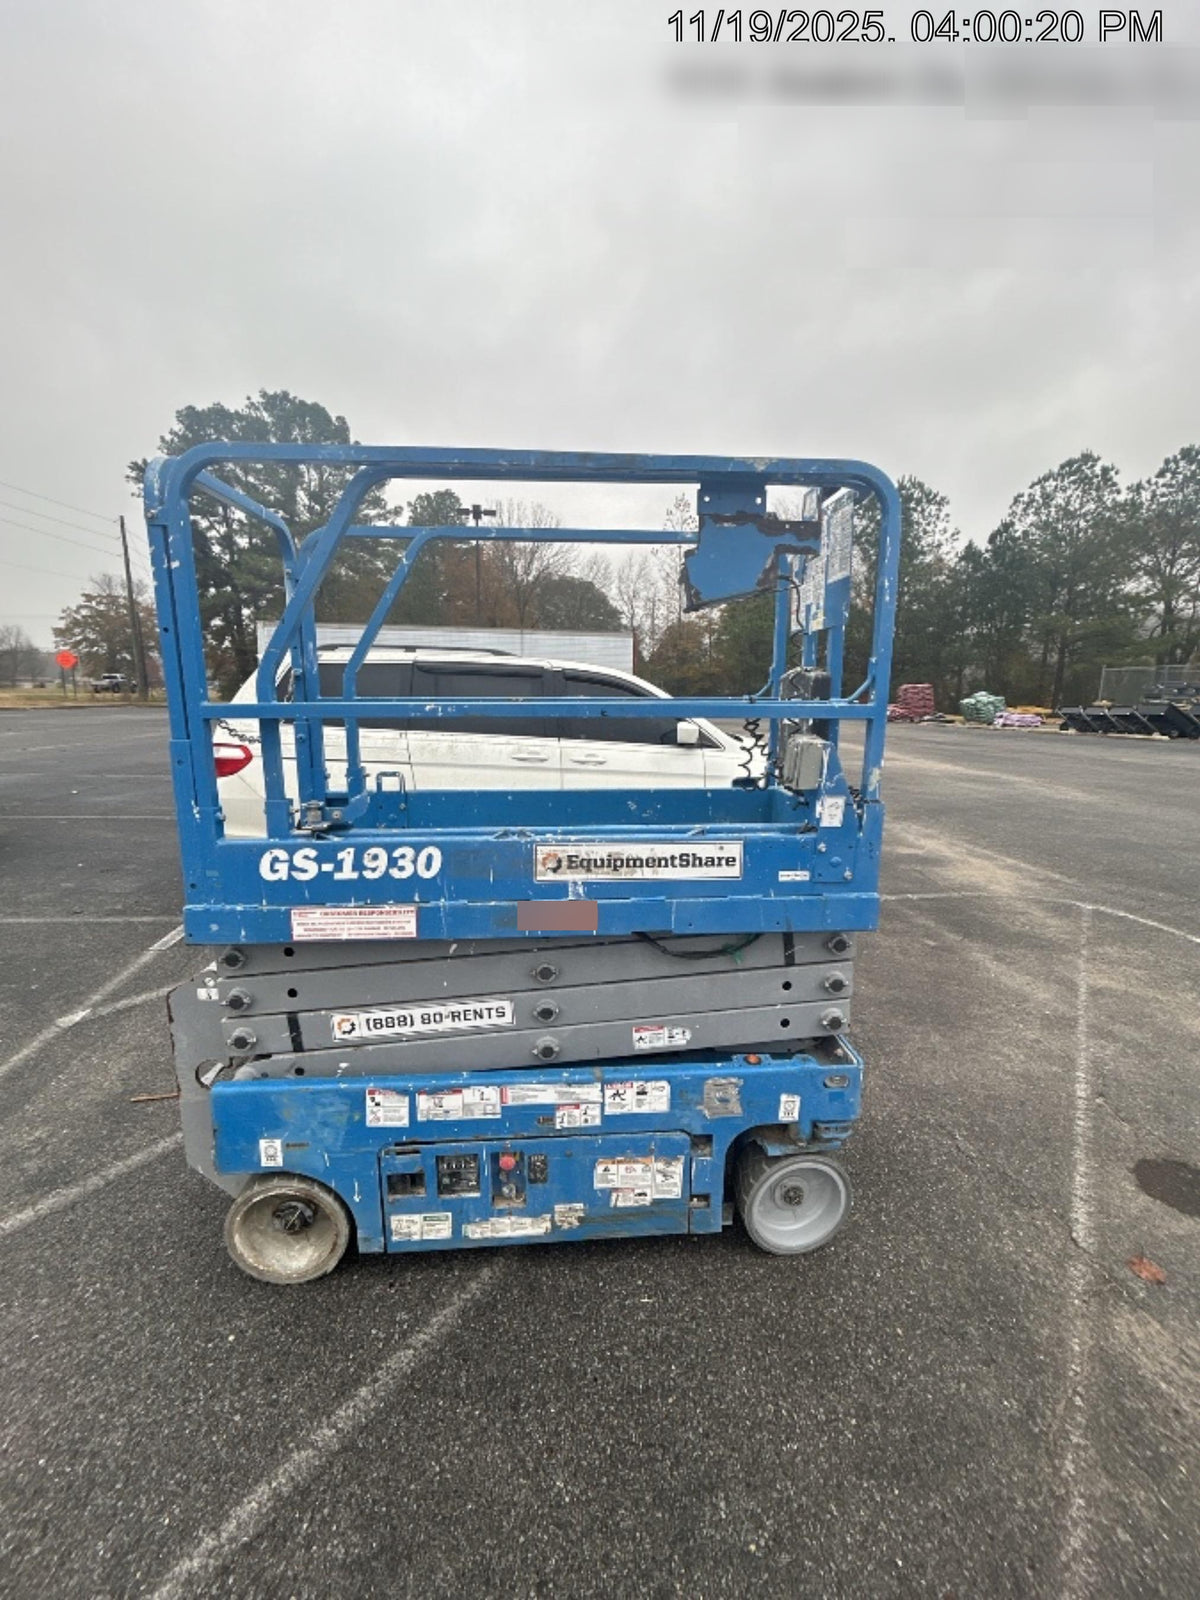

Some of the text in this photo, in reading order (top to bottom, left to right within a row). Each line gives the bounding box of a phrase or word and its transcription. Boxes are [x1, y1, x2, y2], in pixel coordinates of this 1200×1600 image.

[259, 846, 443, 881] GS-1930
[566, 852, 737, 874] EquipmentShare
[365, 1006, 507, 1031] (888) 80-RENTS
